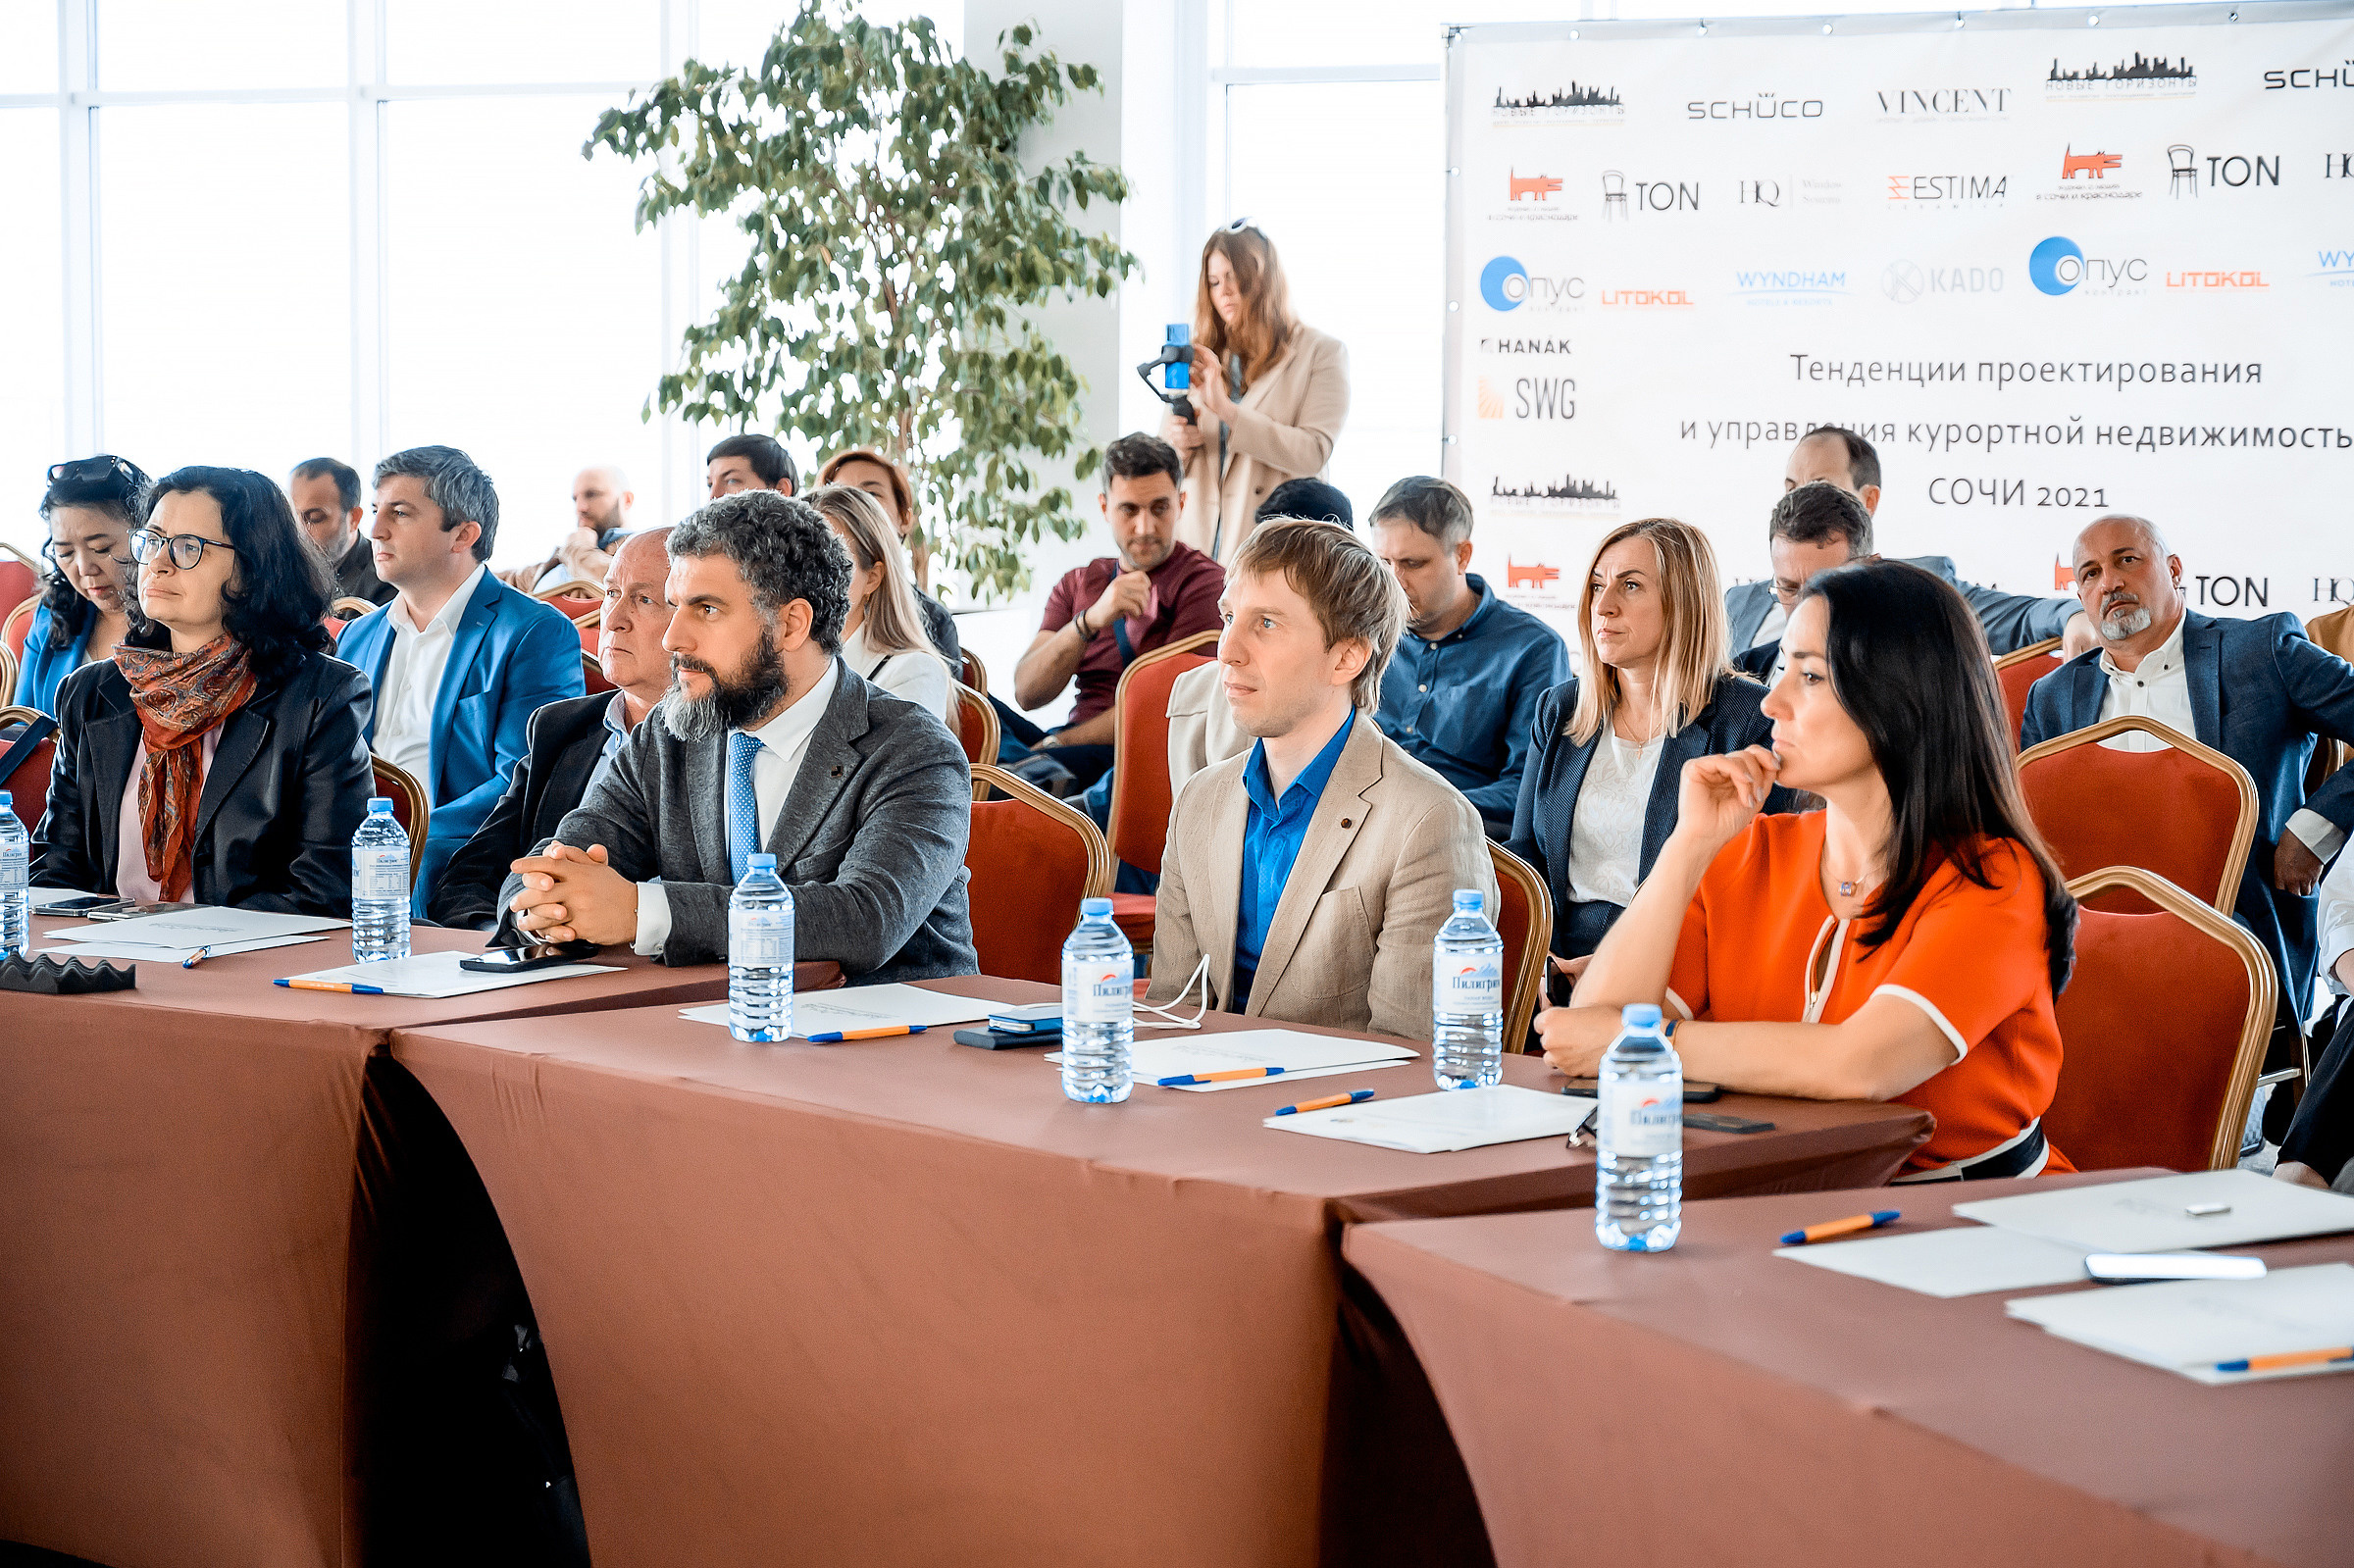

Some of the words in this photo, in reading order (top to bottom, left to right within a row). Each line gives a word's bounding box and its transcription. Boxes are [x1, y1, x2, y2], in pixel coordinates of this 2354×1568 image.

[1688, 92, 1822, 119] SCHÜCO
[1877, 89, 2010, 114] VINCENT
[2207, 156, 2279, 186] TON
[1636, 181, 1699, 211] TON
[1914, 176, 2007, 199] ESTIMA
[1736, 271, 1846, 287] WYNDHAM
[1930, 268, 2005, 292] KADO
[2167, 271, 2270, 287] LITOKOL
[1602, 291, 1694, 305] LITOKOL
[1790, 354, 1966, 387] Тенденции
[1978, 362, 2262, 391] проектирования
[1515, 377, 1576, 420] SWG
[1681, 421, 1696, 440] и
[1908, 416, 2084, 452] курортной
[2096, 425, 2353, 452] недвижимость
[1928, 478, 2024, 506] СОЧИ
[2036, 486, 2110, 507] 2021
[2195, 576, 2269, 607] TON
